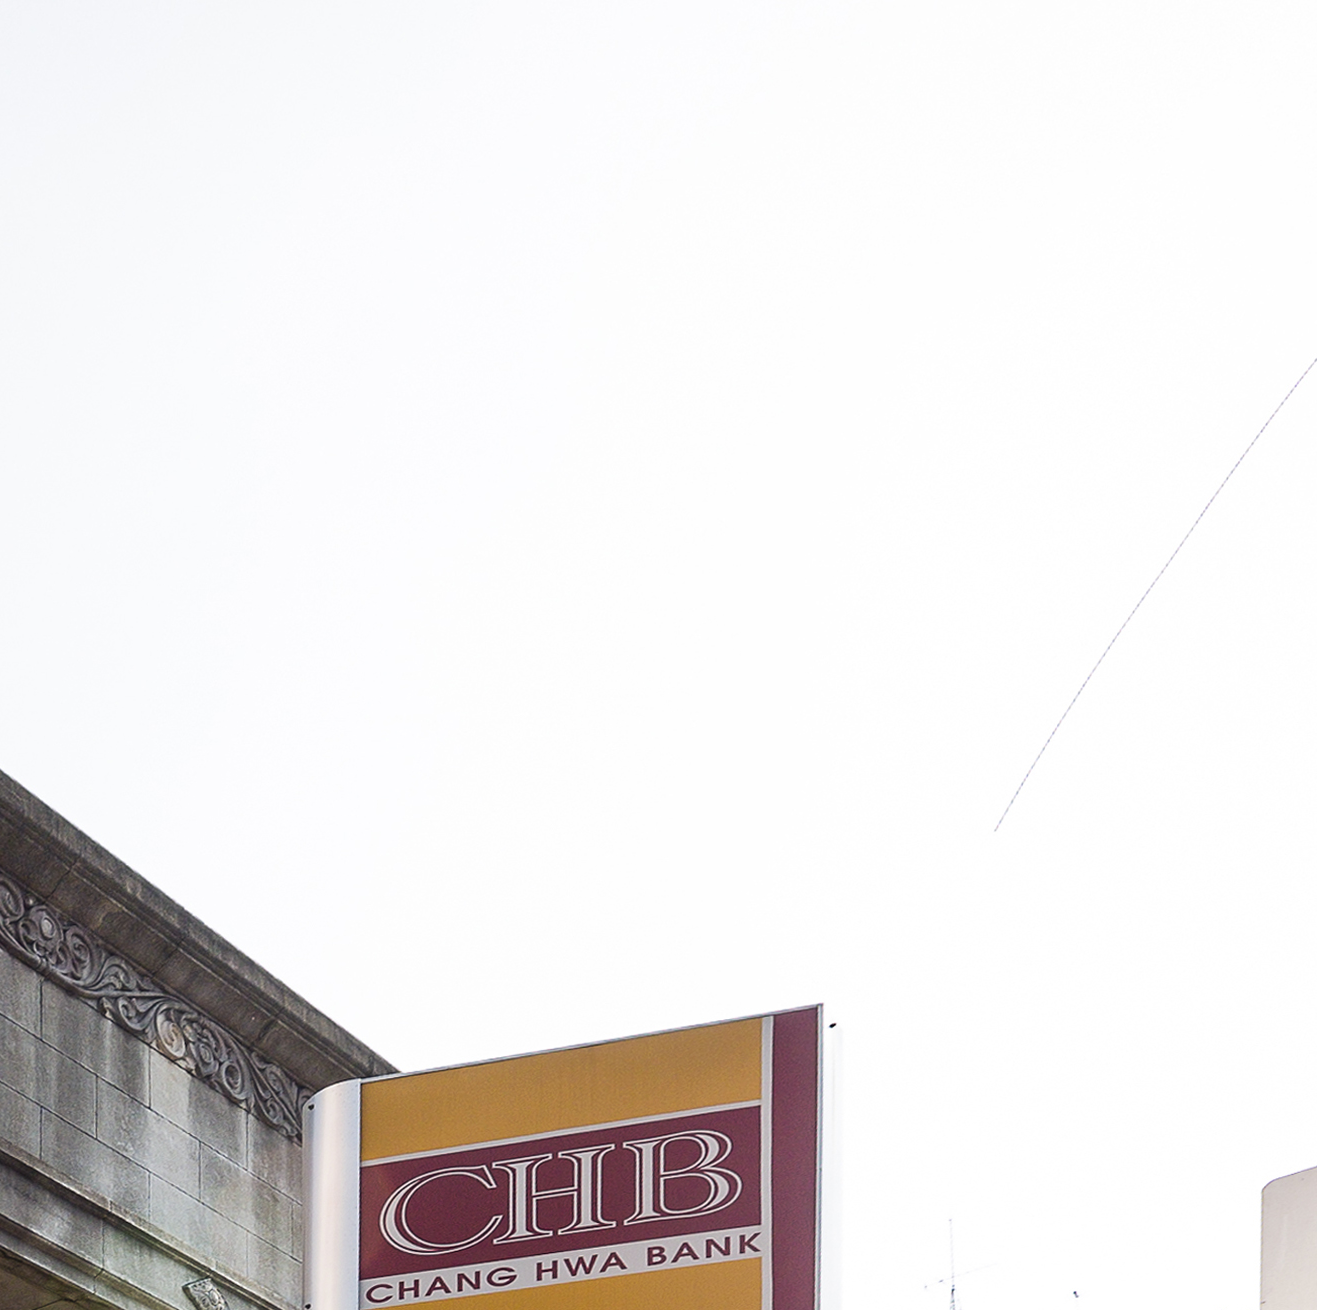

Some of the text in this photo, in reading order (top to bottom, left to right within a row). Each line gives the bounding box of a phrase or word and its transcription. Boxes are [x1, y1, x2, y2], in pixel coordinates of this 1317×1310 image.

[378, 1129, 743, 1256] CHB
[365, 1231, 763, 1305] CHANG HWA BANK
